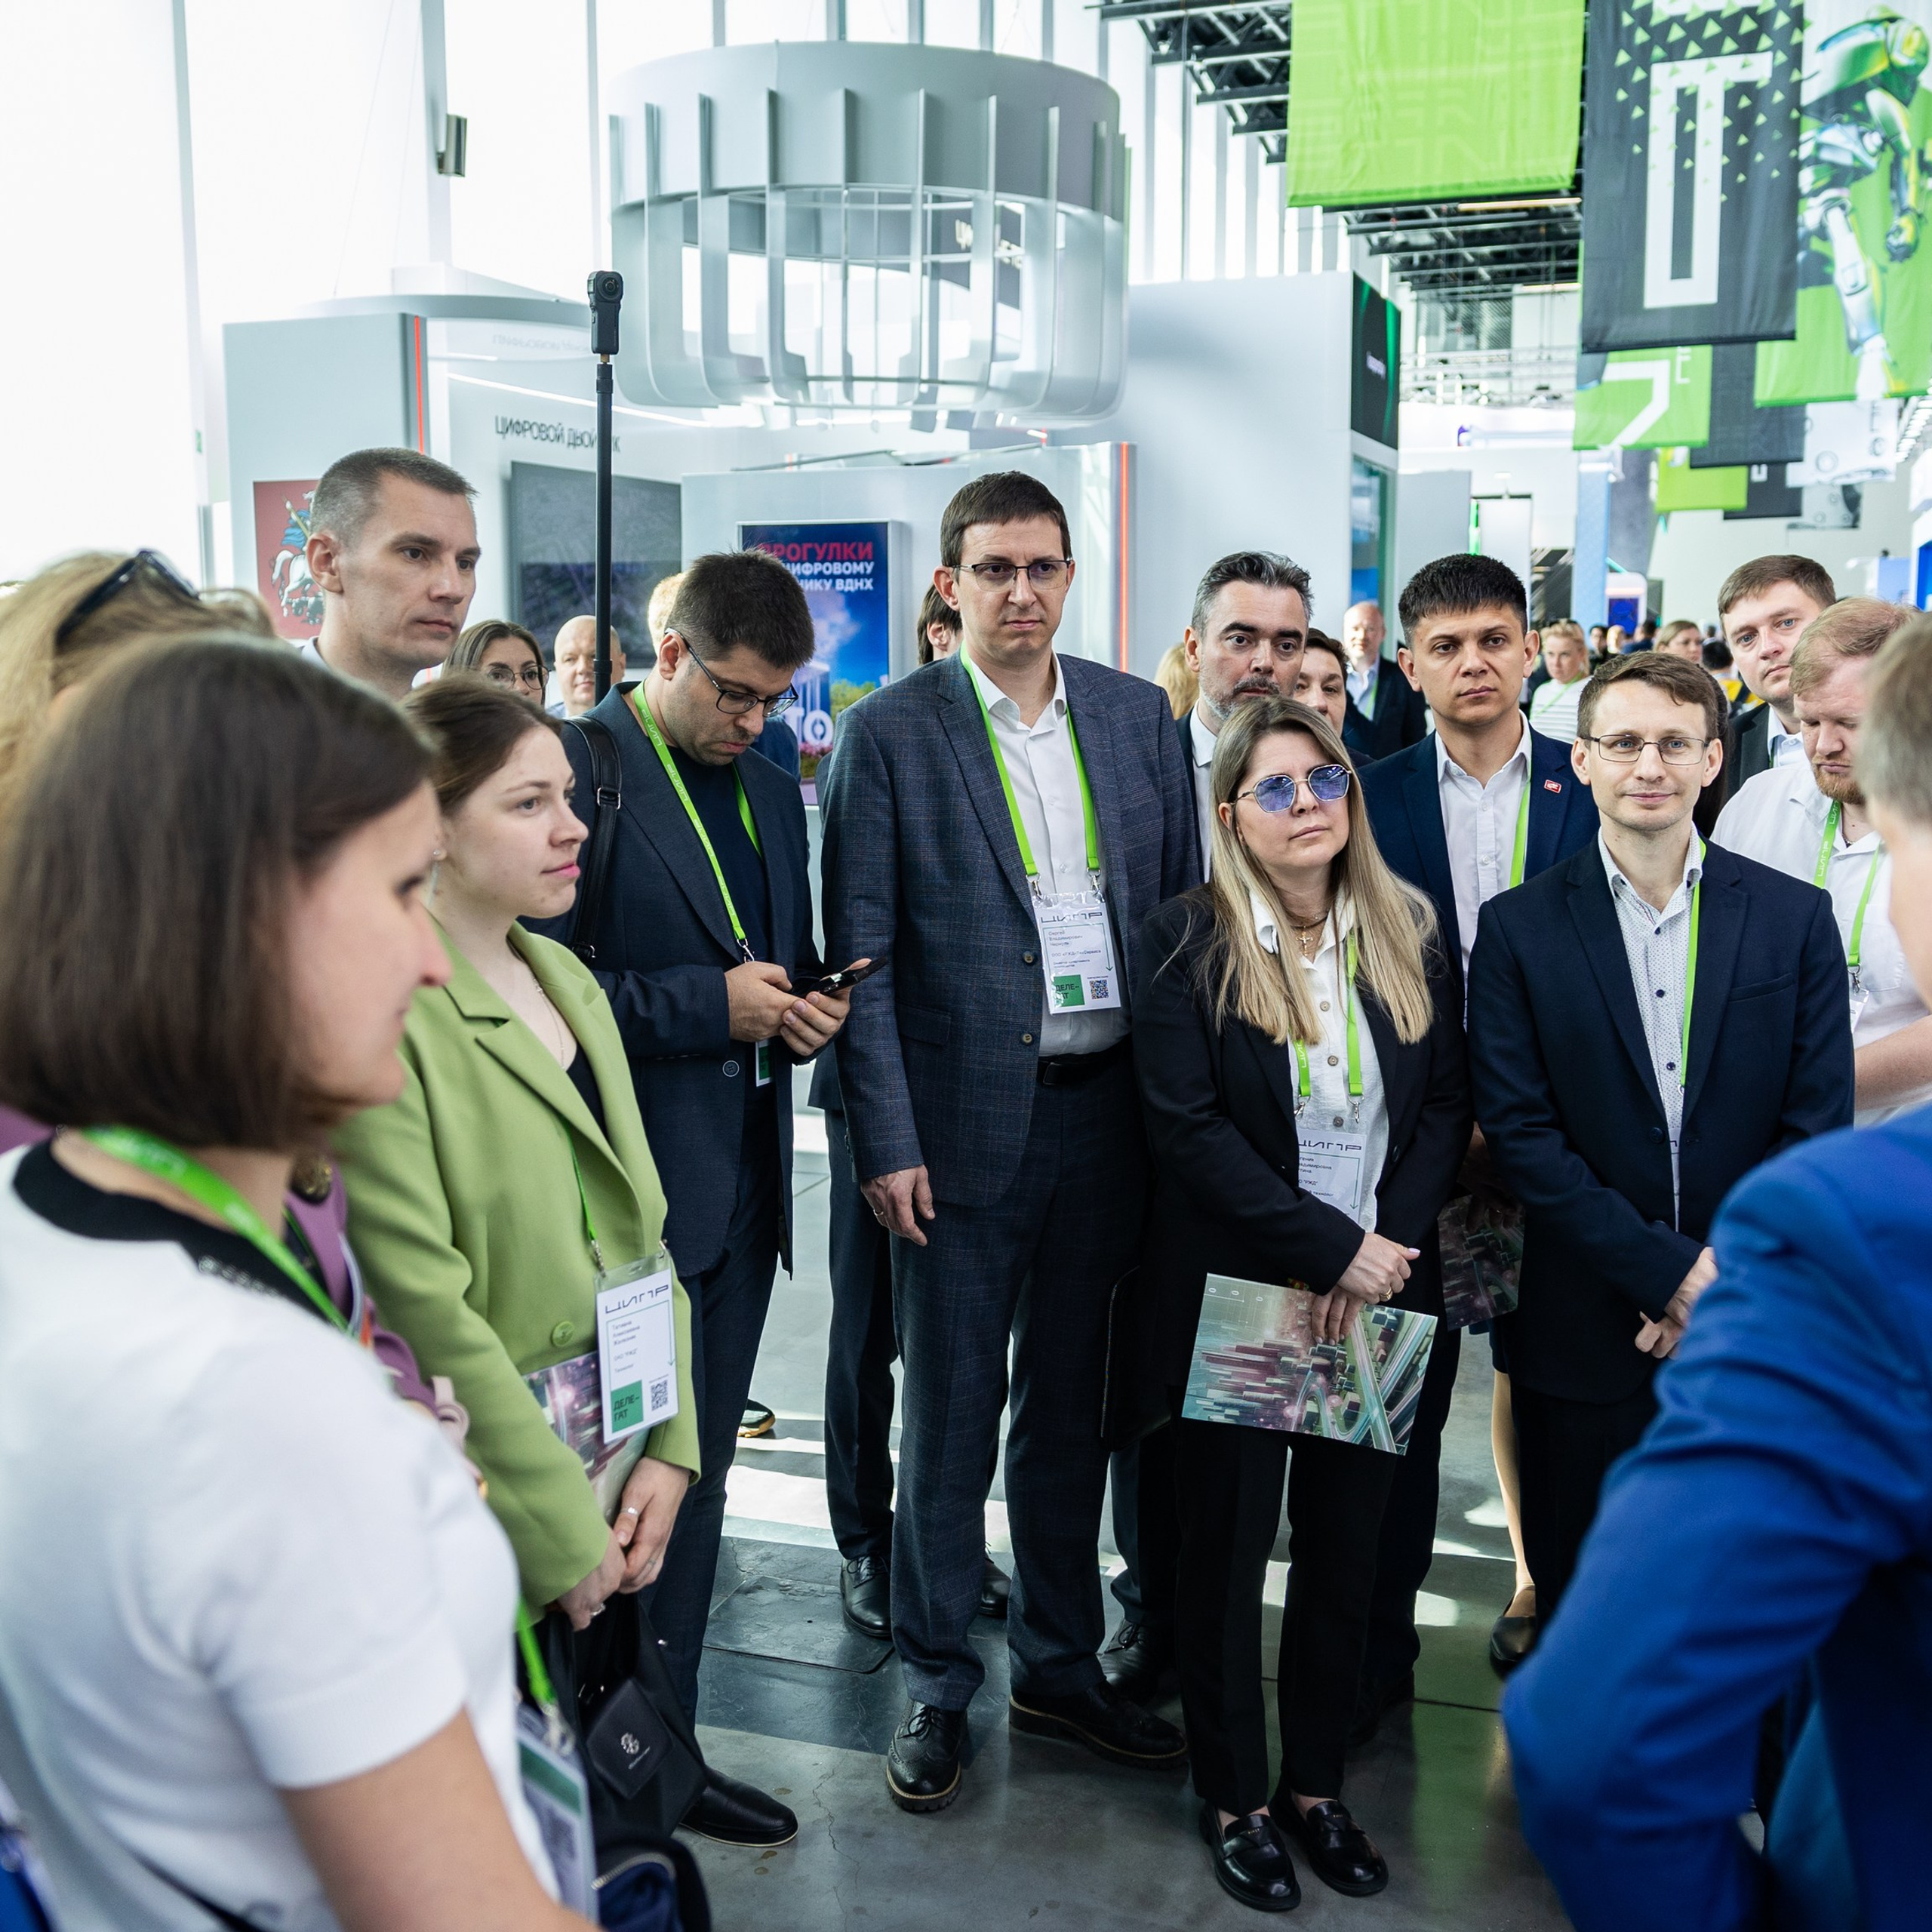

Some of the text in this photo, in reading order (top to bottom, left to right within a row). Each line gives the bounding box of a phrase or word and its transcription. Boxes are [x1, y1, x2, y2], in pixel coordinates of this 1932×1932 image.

[494, 416, 620, 453] ЦИФРОВОЙ ДВОЙК
[835, 578, 873, 592] ВДНХ
[605, 1284, 669, 1314] ЦИПР
[613, 1394, 640, 1412] ДЕЛЕ-
[614, 1408, 628, 1422] ГАТ
